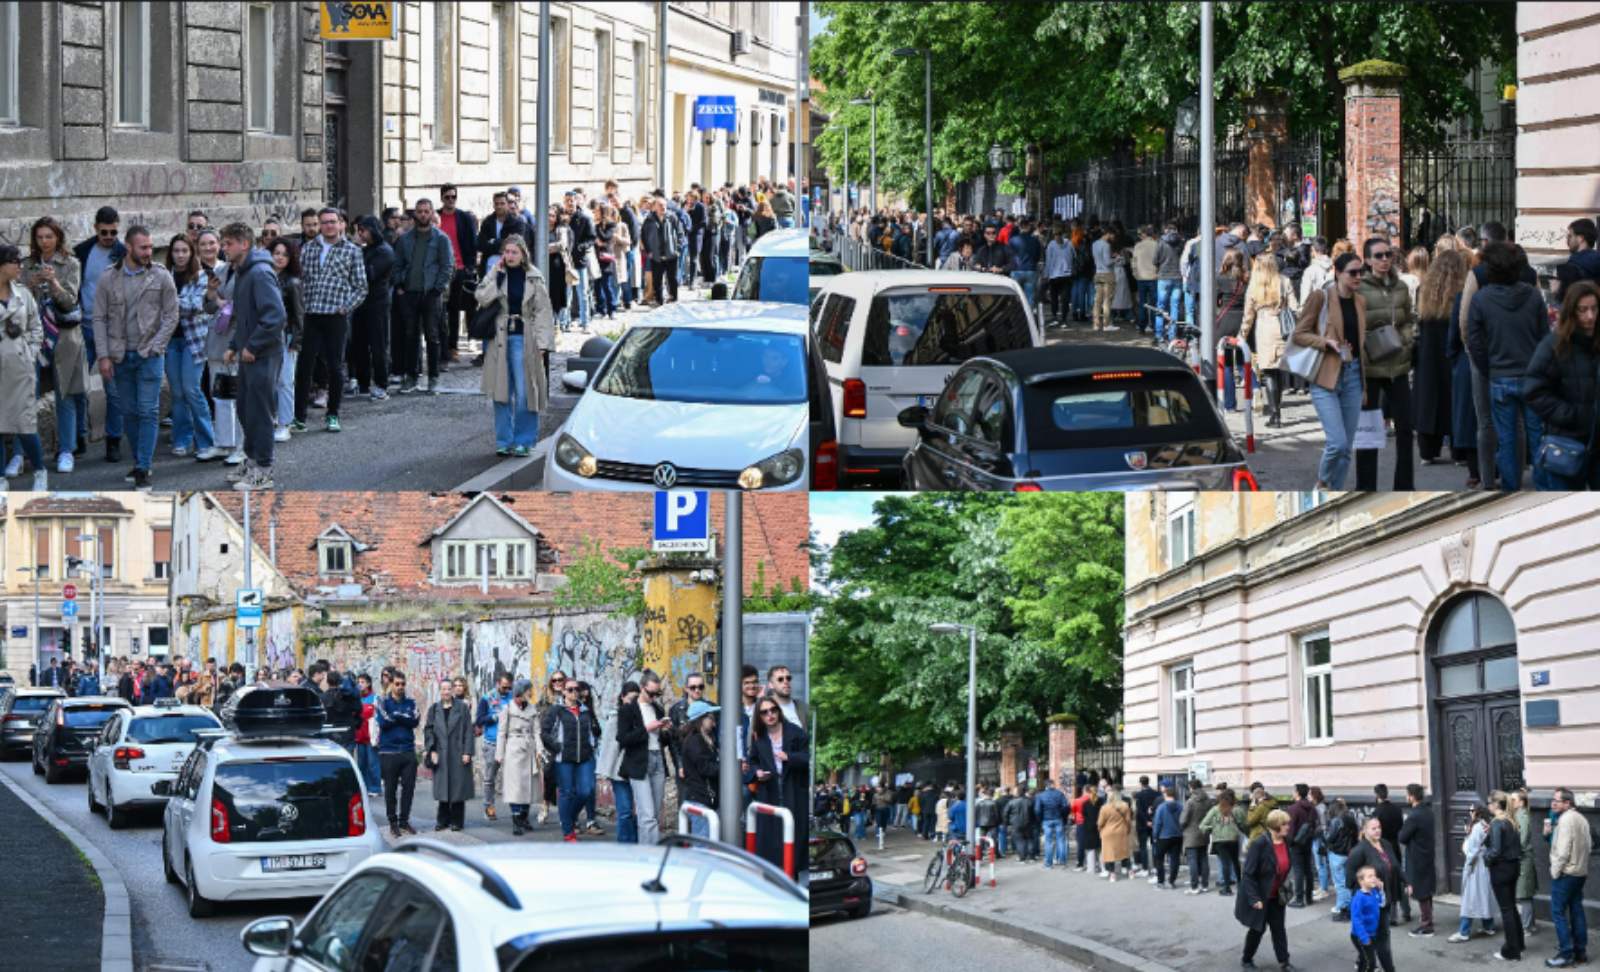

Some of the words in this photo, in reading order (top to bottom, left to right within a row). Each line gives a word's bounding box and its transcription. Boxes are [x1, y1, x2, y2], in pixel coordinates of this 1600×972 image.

[341, 3, 387, 20] SOVA
[698, 103, 735, 115] ZEISS
[666, 491, 698, 531] P
